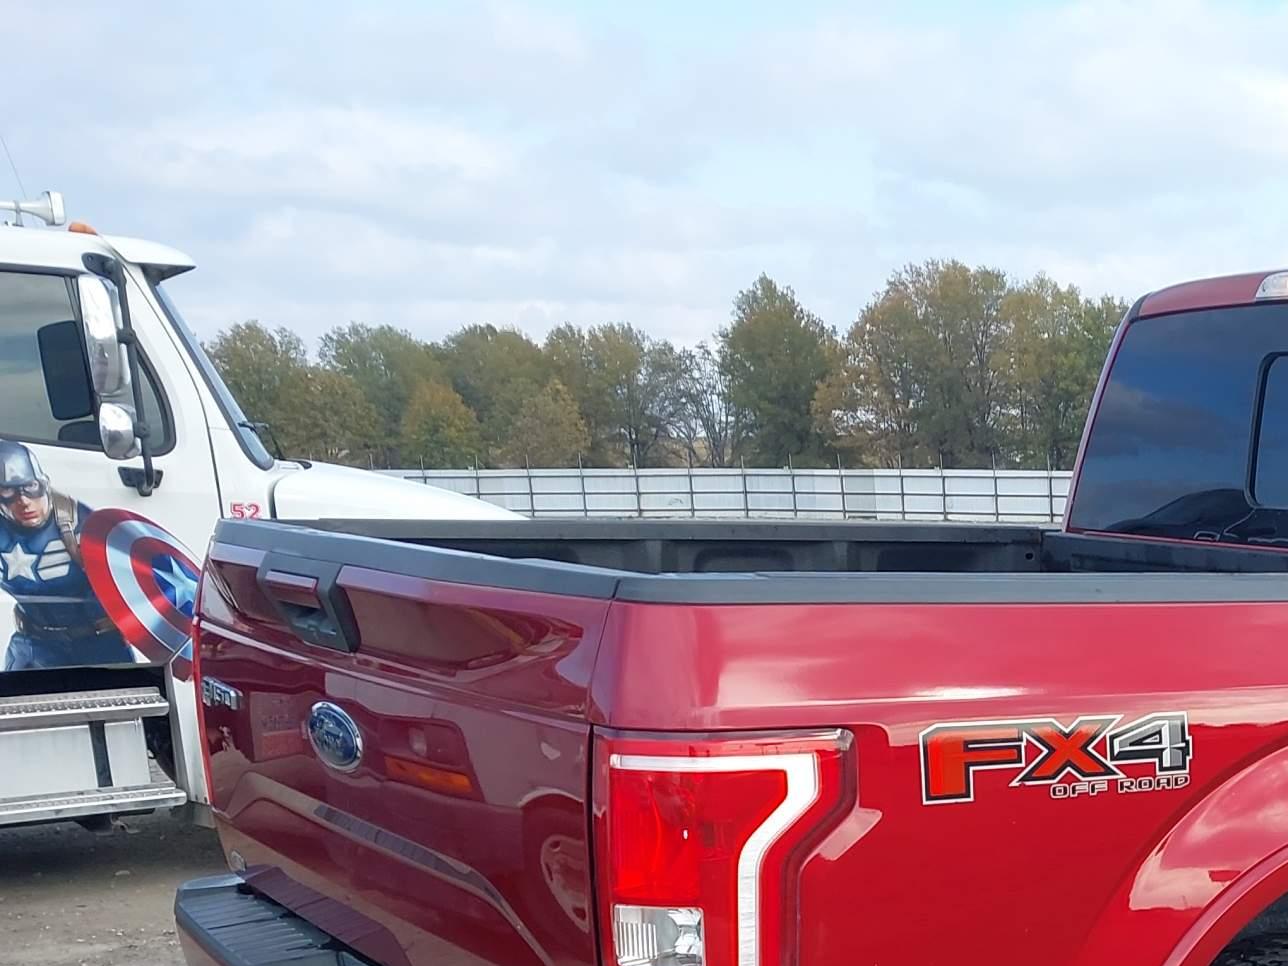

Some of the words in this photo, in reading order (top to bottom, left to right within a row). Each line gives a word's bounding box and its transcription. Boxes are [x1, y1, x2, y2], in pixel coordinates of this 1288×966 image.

[231, 503, 259, 521] 52
[919, 711, 1192, 805] FX4
[1050, 781, 1109, 799] OFF
[1118, 774, 1191, 794] ROAD
